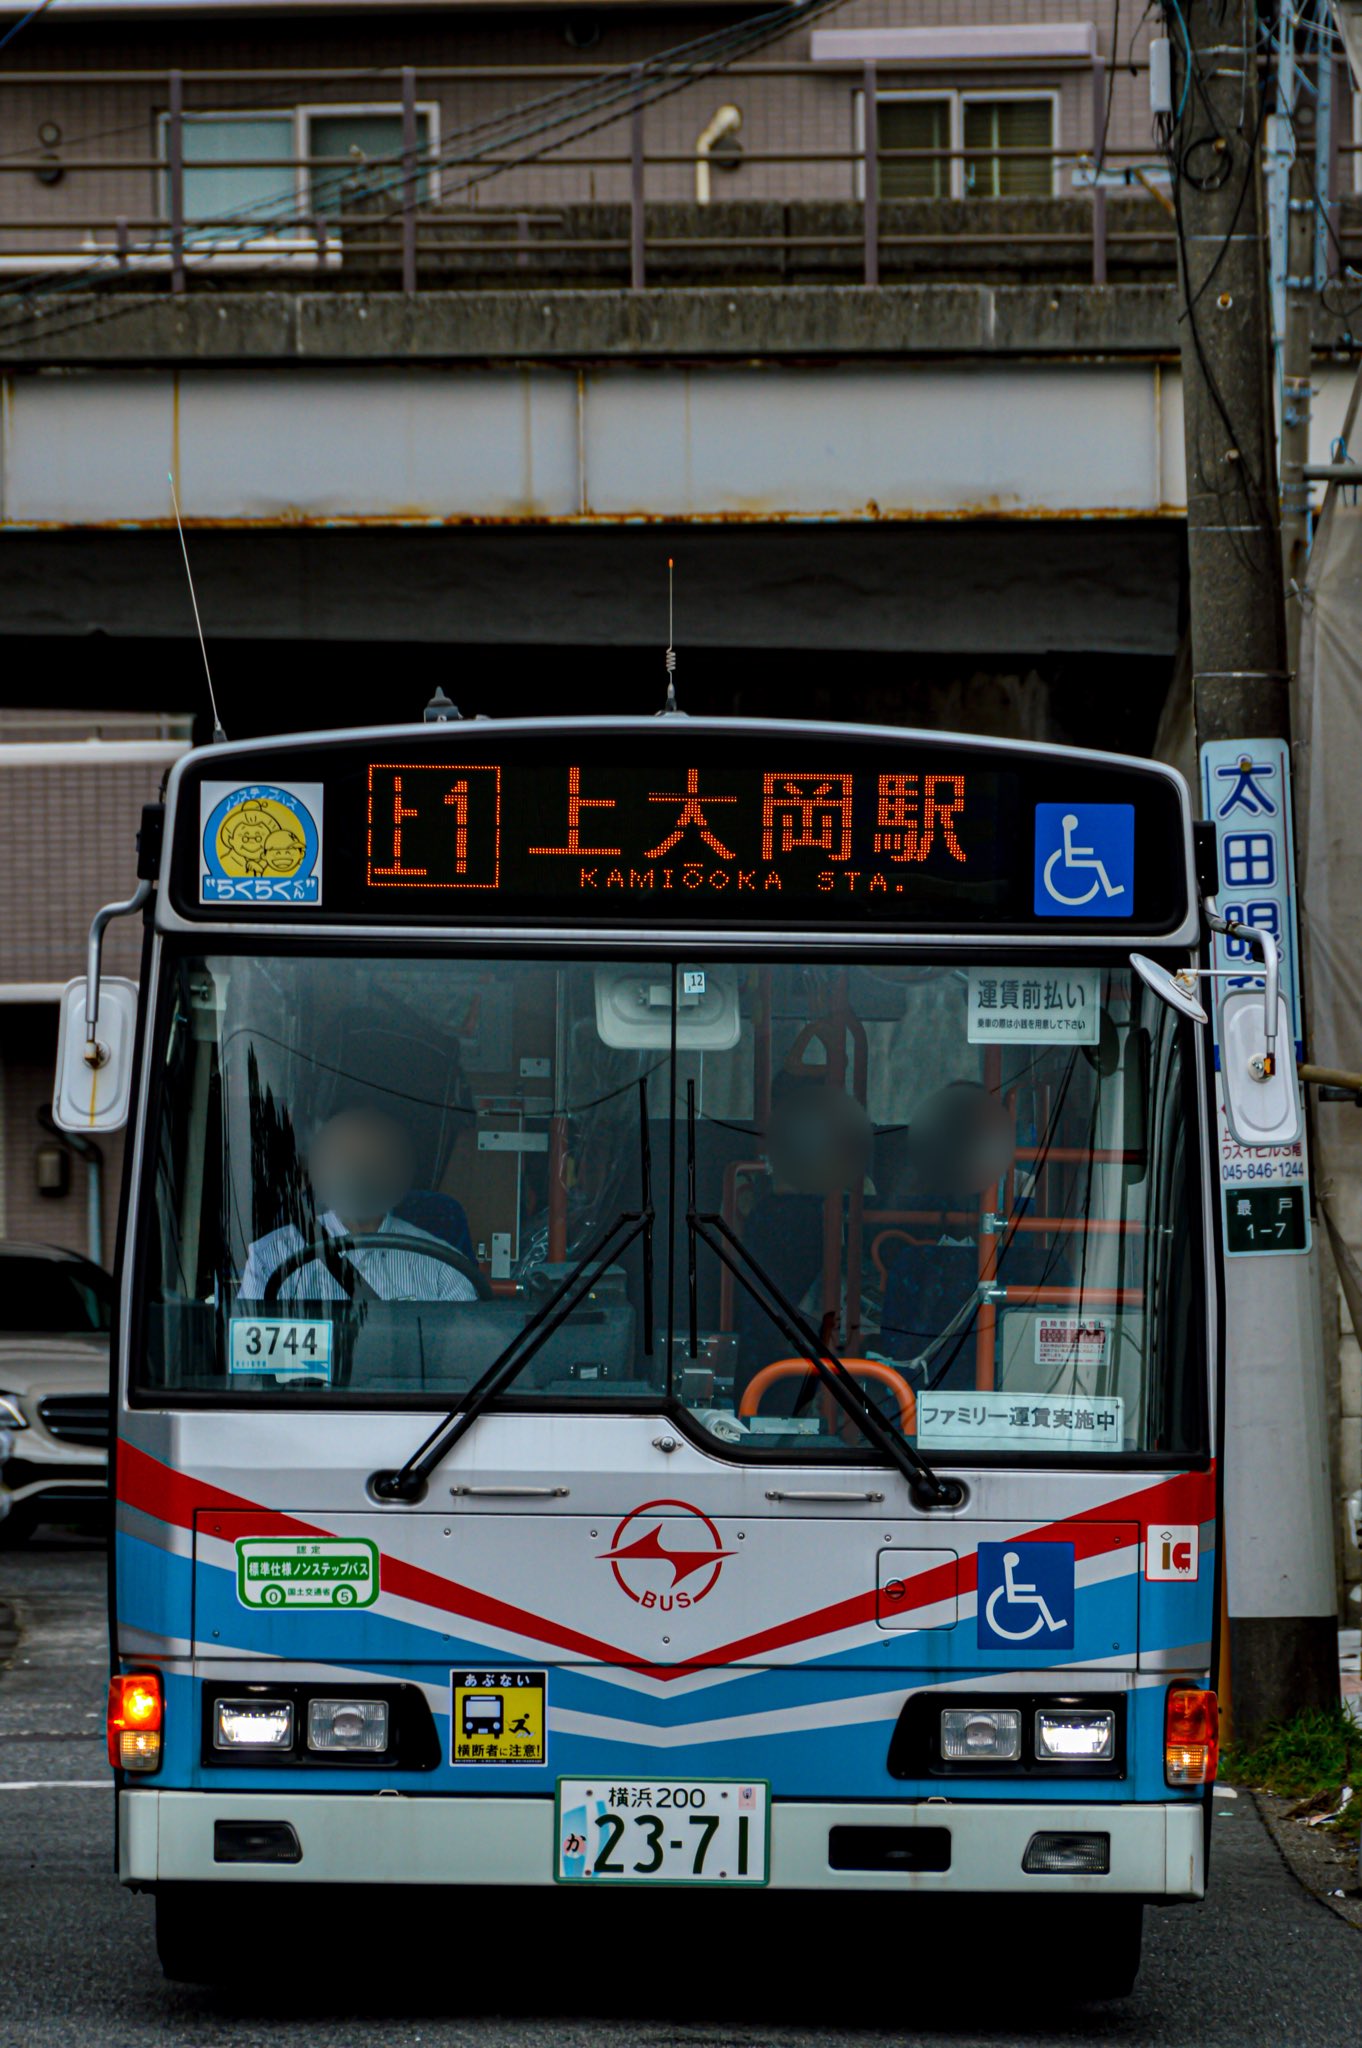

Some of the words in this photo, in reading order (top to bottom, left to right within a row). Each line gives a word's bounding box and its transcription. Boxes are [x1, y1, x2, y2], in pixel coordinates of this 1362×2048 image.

[528, 766, 967, 863] 上大岡駅
[817, 871, 904, 892] STA.
[1216, 756, 1280, 991] 太田眼
[691, 974, 703, 987] 12
[977, 979, 1086, 1010] 運賃前払い
[1221, 1161, 1304, 1181] 045-846-1244
[245, 1326, 318, 1356] 3744
[922, 1406, 1115, 1431] ファミリー運賃実施中
[248, 1561, 369, 1577] 標準仕様ノンステップバス
[287, 1587, 331, 1597] 国土交通省
[340, 1591, 350, 1603] 5
[640, 1590, 692, 1612] BUS
[464, 1673, 531, 1687] あぶない
[565, 1832, 587, 1853] か
[593, 1813, 749, 1876] 23-71
